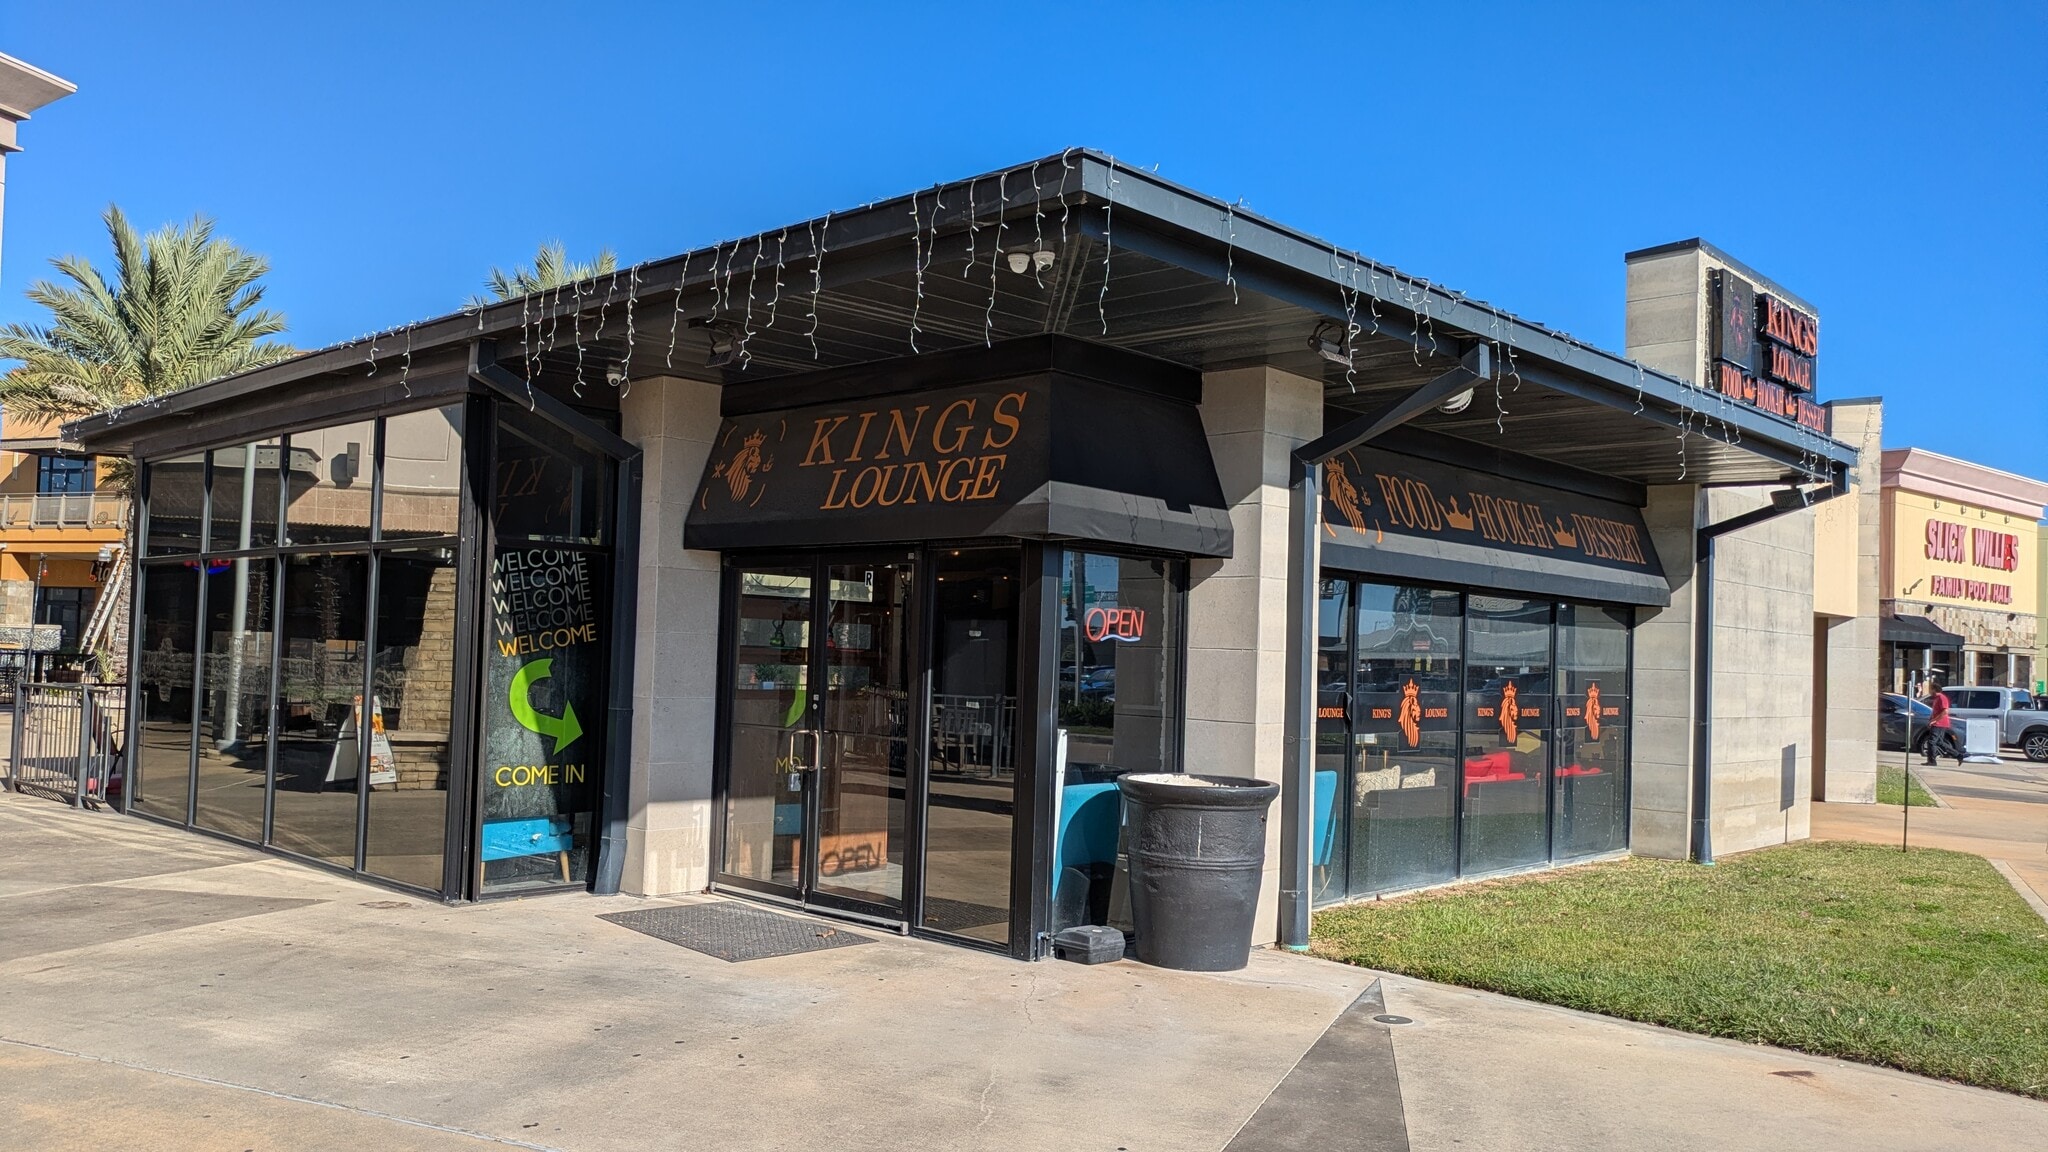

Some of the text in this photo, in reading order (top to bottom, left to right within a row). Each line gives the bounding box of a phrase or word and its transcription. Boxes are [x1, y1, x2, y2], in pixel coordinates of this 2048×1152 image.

[1766, 297, 1816, 357] KINGS
[1772, 345, 1811, 391] LOUNGE
[1721, 364, 1826, 432] FOOD HOOKAH DESSERT
[799, 391, 1028, 467] KINGS
[820, 454, 1008, 510] LOUNGE
[1375, 473, 1647, 565] FOOD HOOKAH DESSERT
[1925, 518, 1968, 565] SLICK
[492, 562, 589, 594] WELCOME
[1930, 575, 2013, 605] FAMILY POOL HALL
[492, 582, 592, 615] WELCOME
[495, 602, 594, 636] WELCOME
[1086, 608, 1145, 642] OPEN
[498, 623, 597, 657] WELCOME
[1424, 708, 1448, 718] LOUNGE
[1521, 708, 1540, 717] LOUNGE
[1602, 707, 1619, 716] LOUNGE
[495, 763, 585, 787] COME IN
